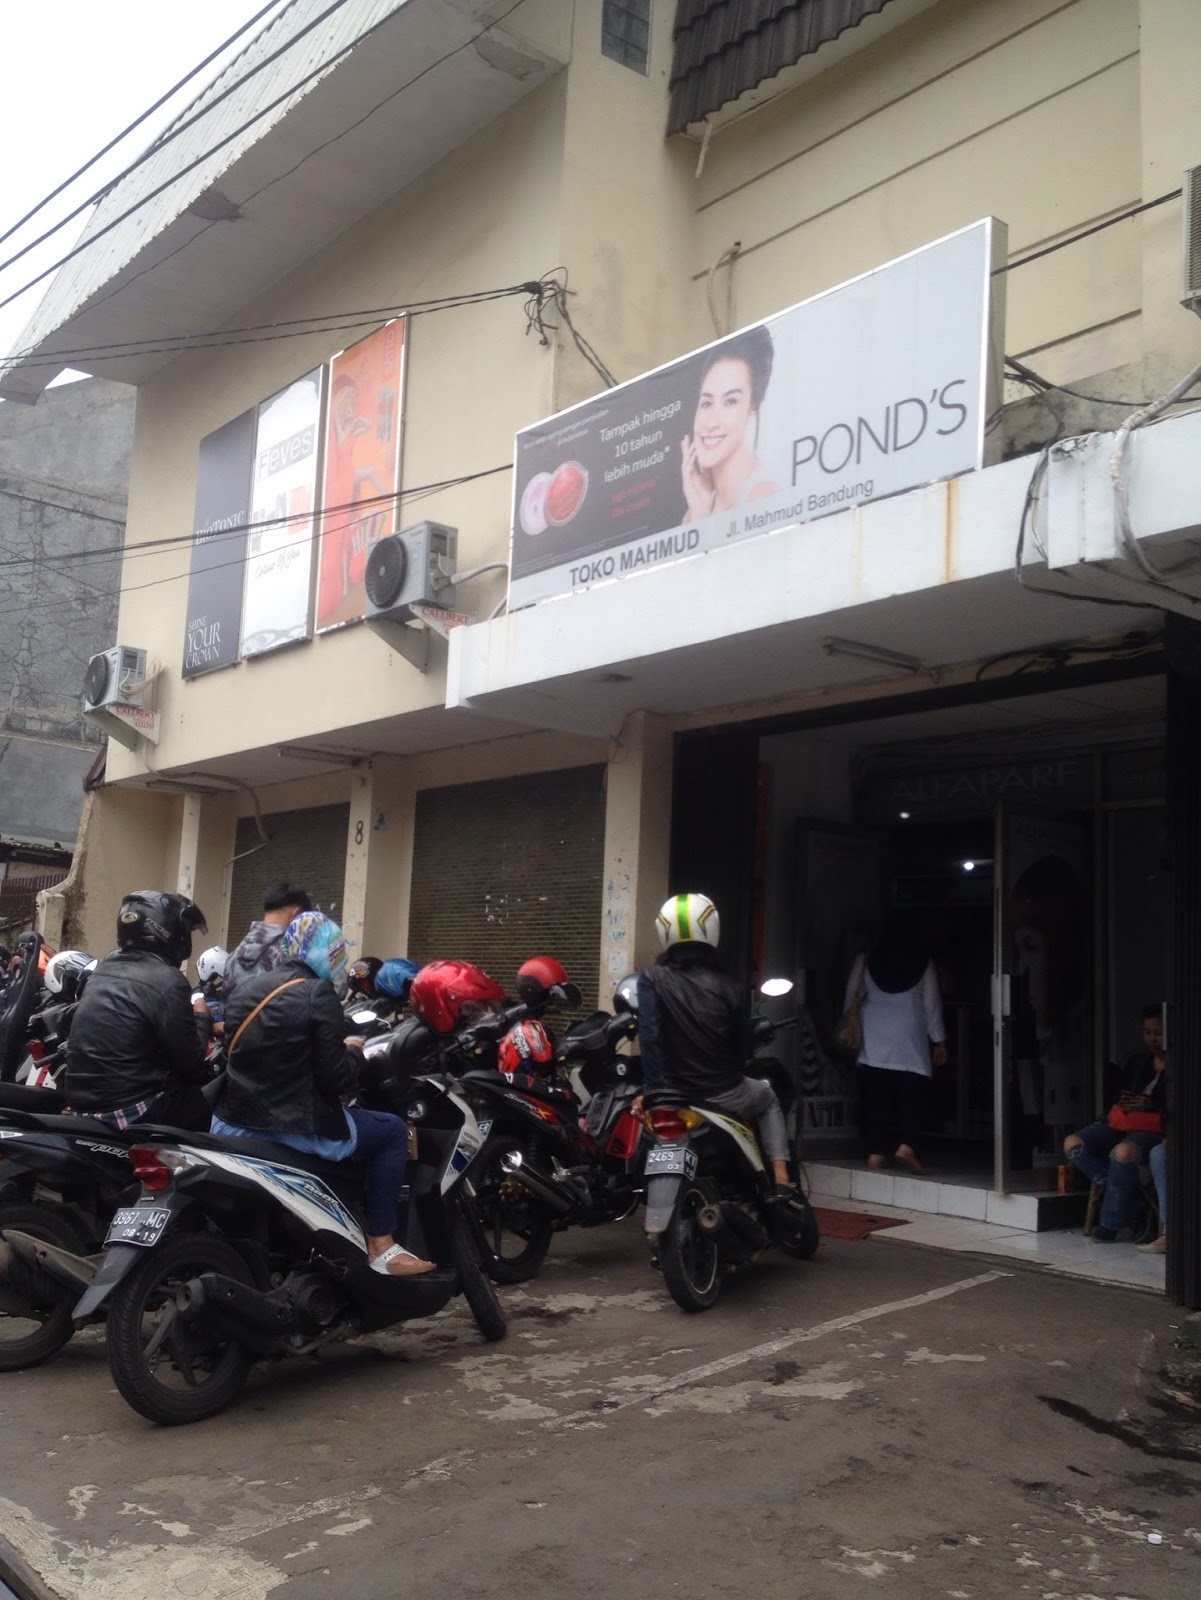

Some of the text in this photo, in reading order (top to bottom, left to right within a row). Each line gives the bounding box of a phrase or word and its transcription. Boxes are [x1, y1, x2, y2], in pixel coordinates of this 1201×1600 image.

[599, 415, 641, 442] Tampak
[642, 400, 681, 421] hingga
[791, 379, 967, 487] POND'S
[615, 430, 662, 457] 10 tahun
[604, 462, 630, 482] lebih
[744, 499, 803, 531] Mahmud
[807, 480, 874, 511] Bandung
[569, 556, 615, 587] TOKO
[619, 529, 700, 571] MAHMUD
[188, 615, 207, 631] SHINE
[187, 621, 221, 653] YOUR
[185, 645, 220, 669] CROWN
[355, 820, 363, 845] 8
[648, 1151, 675, 1163] 2469
[145, 1211, 166, 1229] MC
